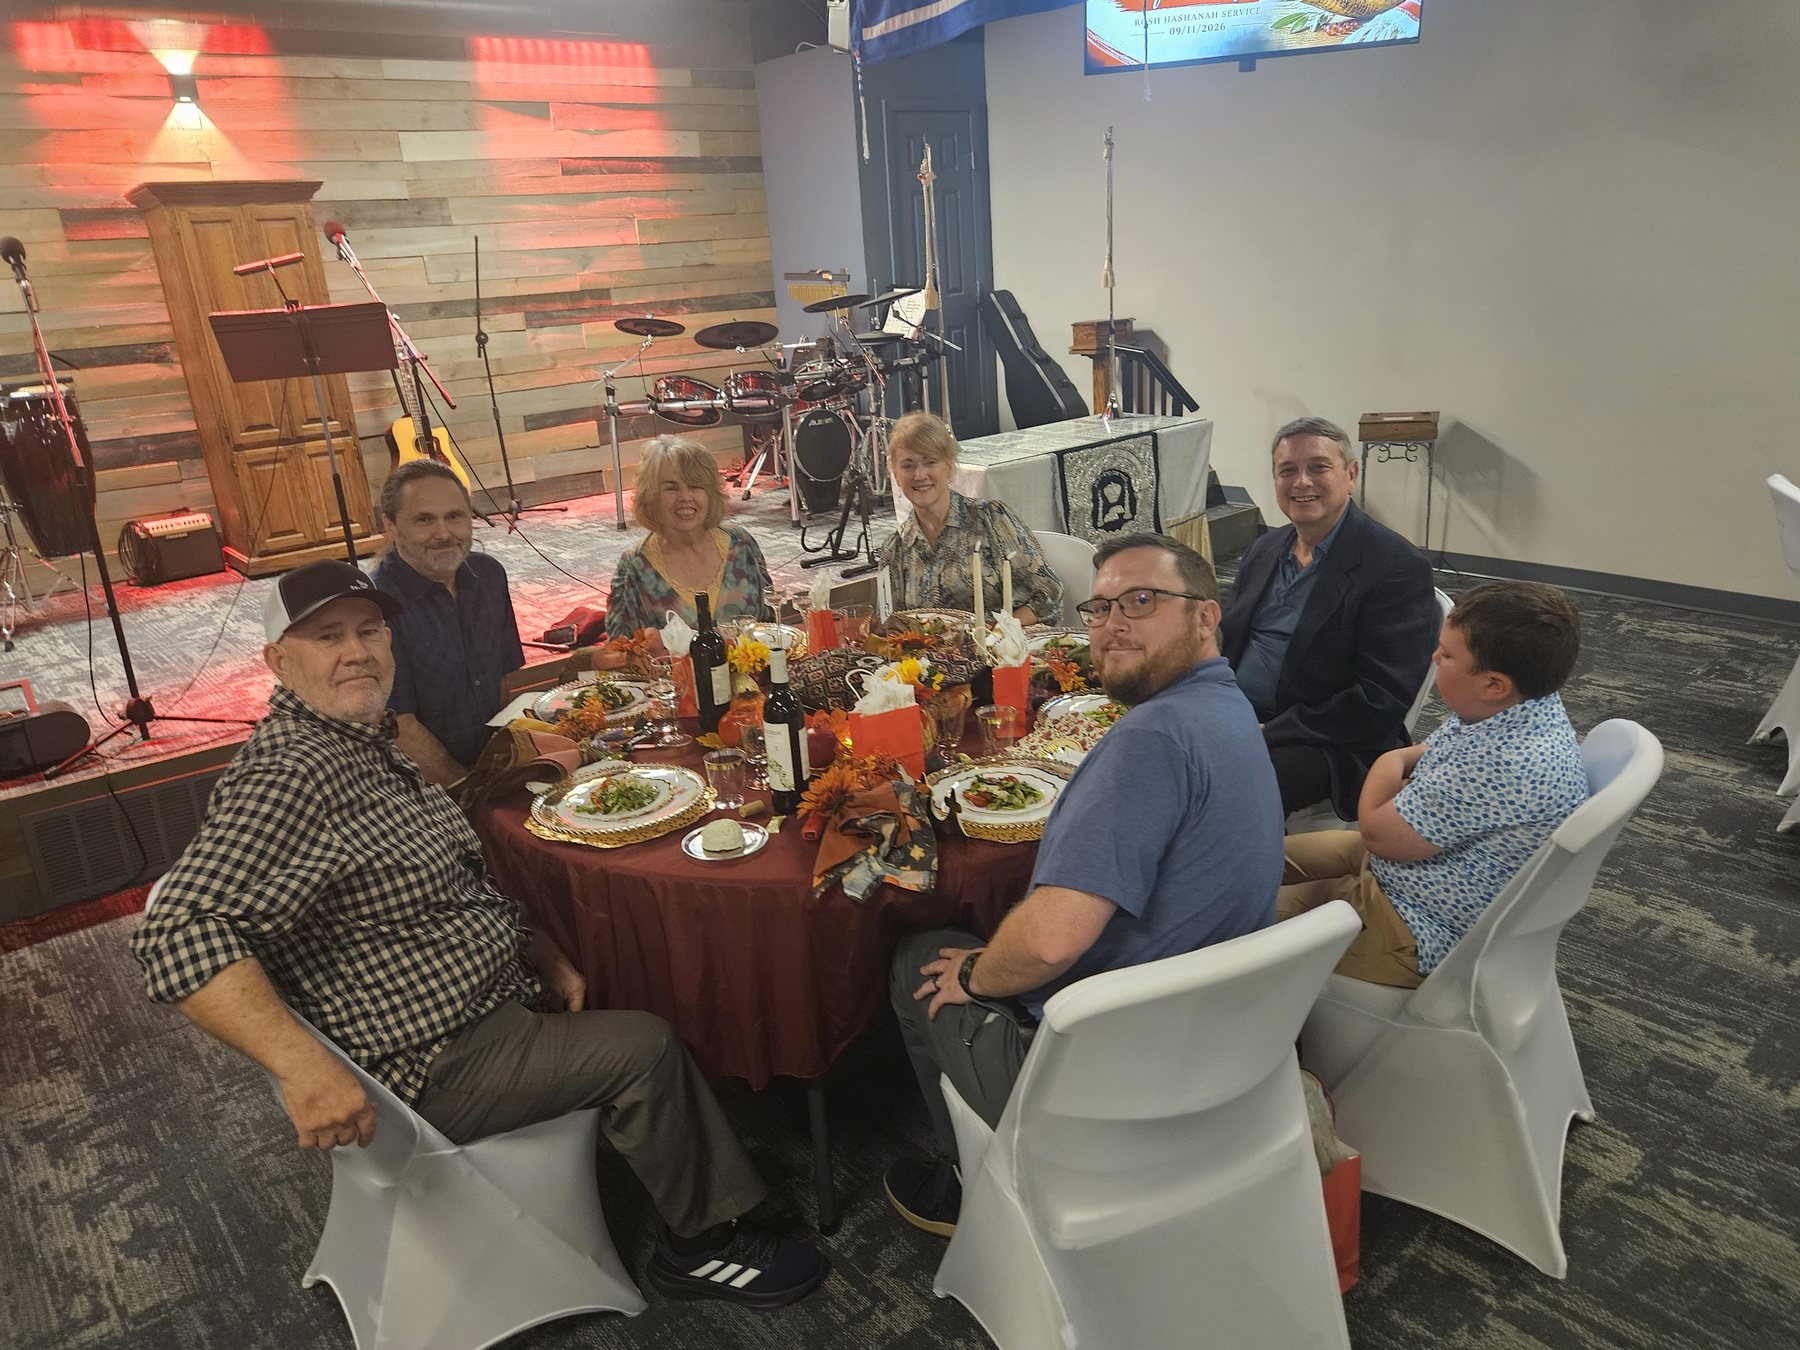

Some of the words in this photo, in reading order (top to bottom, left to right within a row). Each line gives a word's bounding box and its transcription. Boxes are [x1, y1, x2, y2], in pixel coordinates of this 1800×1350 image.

[1164, 11, 1218, 23] HASHANAH
[1221, 7, 1261, 17] SERVICE
[1169, 23, 1226, 35] 09/11/2026
